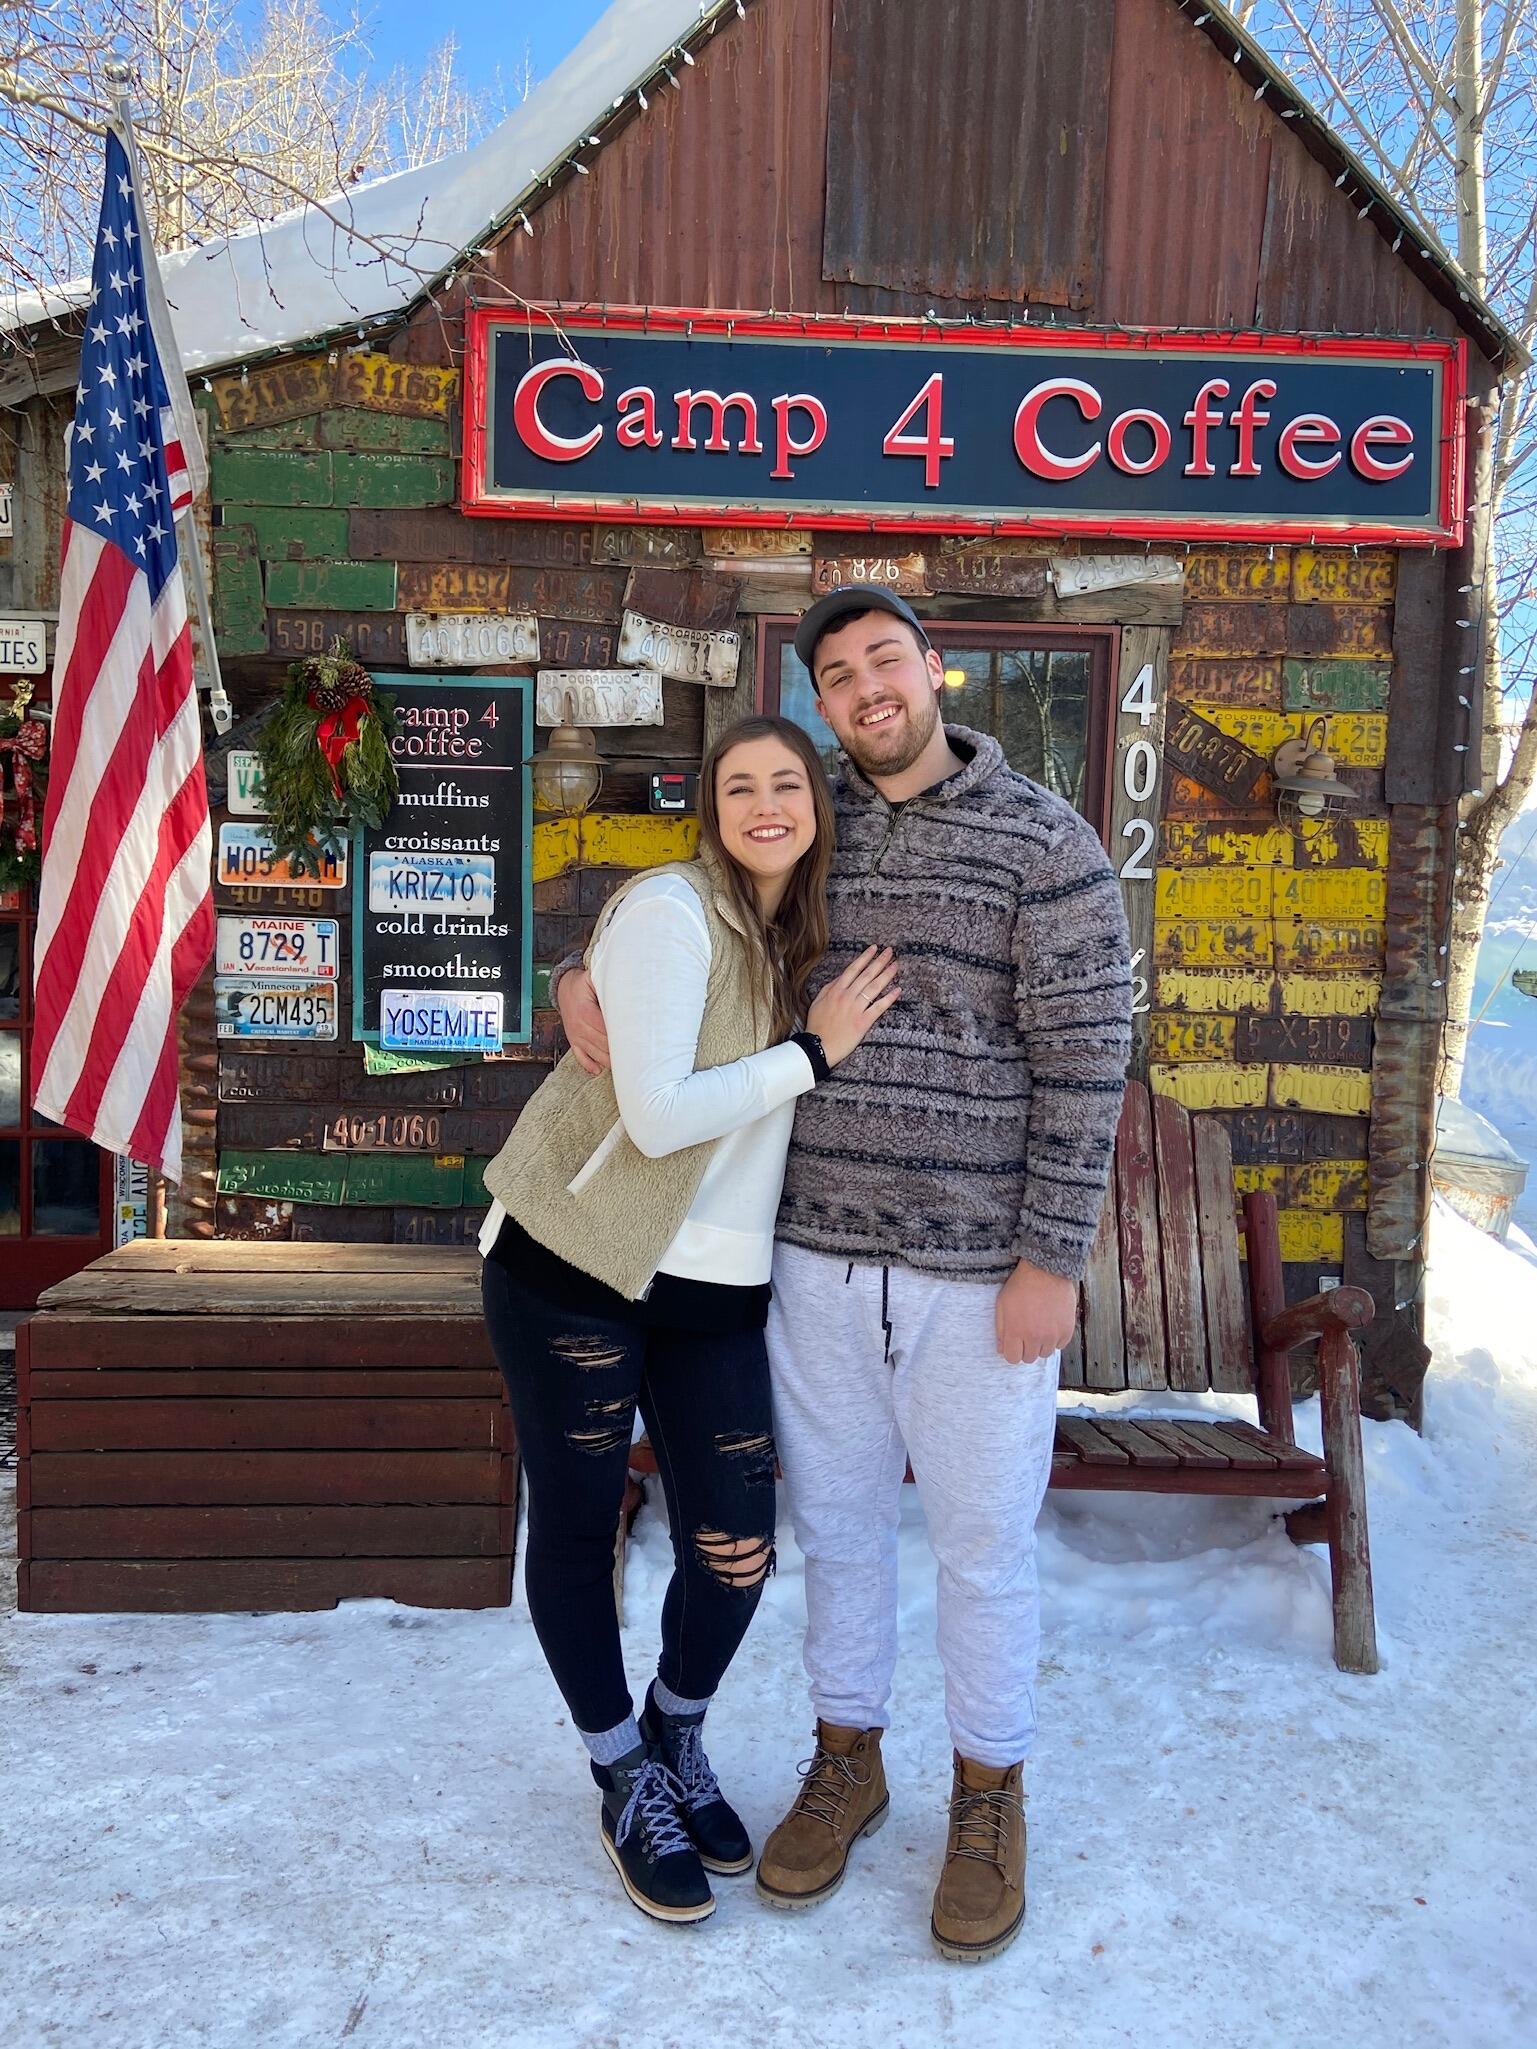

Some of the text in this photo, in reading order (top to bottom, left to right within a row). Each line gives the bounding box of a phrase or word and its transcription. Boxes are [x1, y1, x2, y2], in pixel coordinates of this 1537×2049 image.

[512, 357, 1416, 488] Camp 4 Coffee
[653, 623, 709, 642] COLORADO
[392, 700, 500, 738] camp 4
[1216, 713, 1280, 724] COLORFUL
[390, 727, 484, 758] coffee
[233, 756, 252, 768] SEP
[396, 781, 490, 809] muffins
[384, 830, 501, 853] croissants
[401, 856, 453, 866] ALASKA
[1183, 869, 1246, 878] COLORFUL
[1302, 869, 1366, 878] COLORFUL
[389, 870, 475, 902] KRIZ10
[1165, 877, 1262, 904] 40T320
[1284, 877, 1381, 905] 40T318
[1181, 905, 1244, 914] COLORADO
[1301, 905, 1364, 915] COLORADO
[252, 920, 305, 931] MAINE
[375, 913, 509, 937] cold drinks
[1304, 919, 1367, 929] COLORFUL
[239, 931, 331, 963] 8729 T
[222, 962, 235, 971] JAN
[244, 962, 309, 973] Vacationland
[382, 952, 502, 979] smoothies
[250, 981, 301, 991] Minnesota
[249, 995, 327, 1026] 2CM435
[219, 1024, 233, 1033] FEB
[386, 1007, 497, 1038] YOSEMITE
[1306, 1049, 1365, 1061] WYOMING
[1301, 1063, 1360, 1078] COLORADO
[332, 1113, 441, 1147] 40-1060
